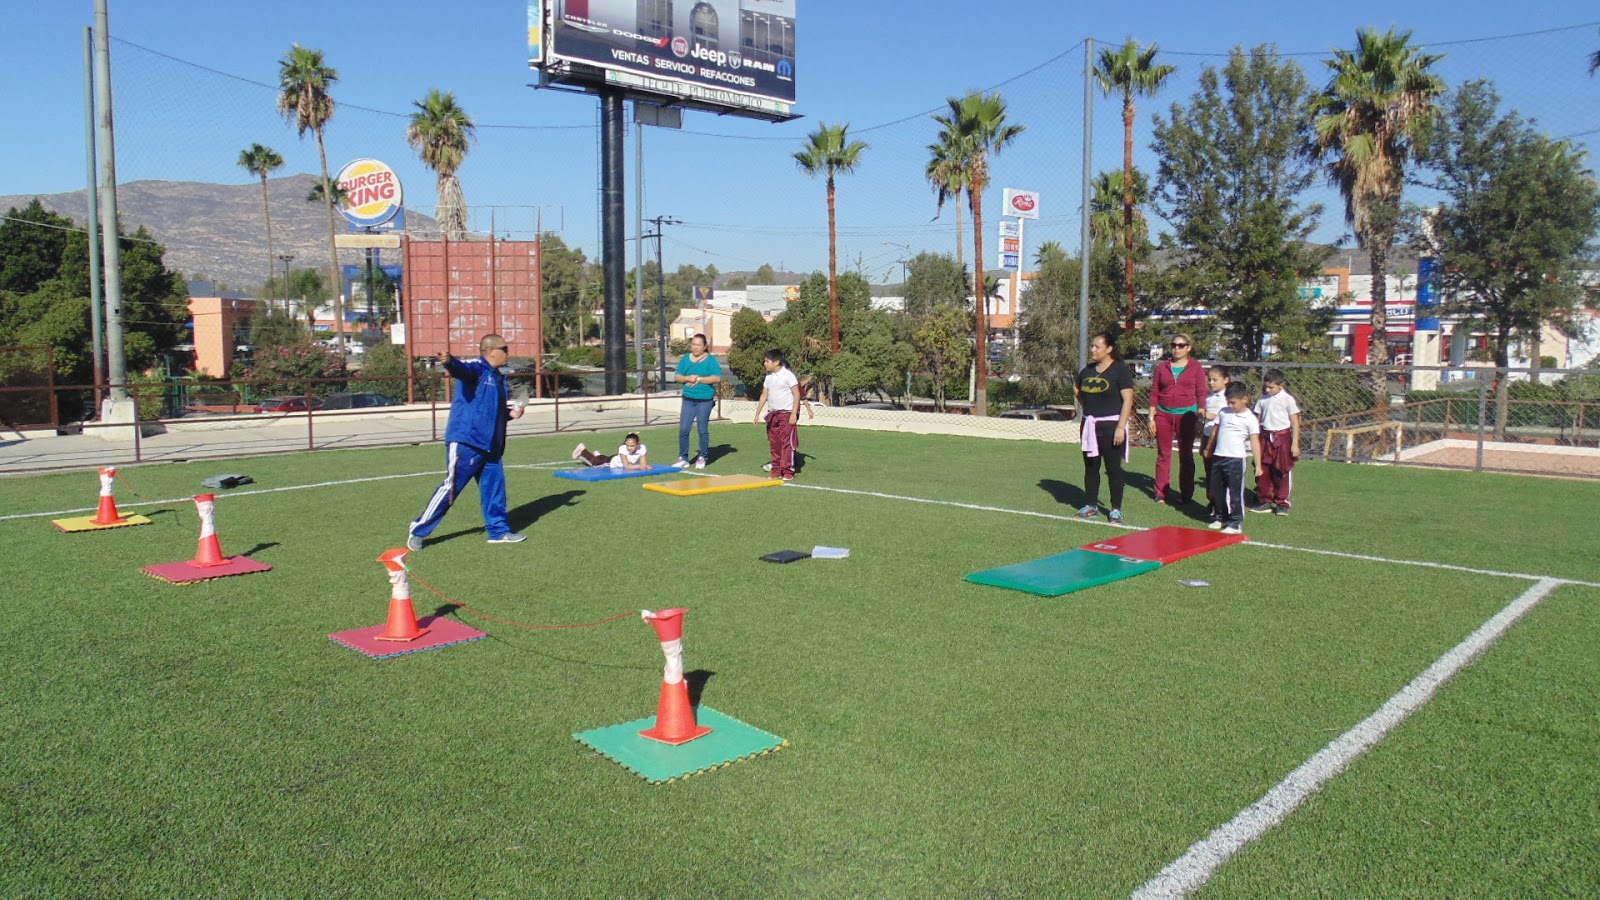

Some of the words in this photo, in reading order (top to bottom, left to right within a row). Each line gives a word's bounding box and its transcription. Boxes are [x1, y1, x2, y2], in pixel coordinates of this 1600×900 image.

[565, 14, 608, 27] CHRYSLER
[612, 29, 660, 44] DODGE
[690, 43, 726, 66] Jeep
[611, 48, 650, 65] VENTAS
[654, 58, 696, 75] SERVICIO
[700, 67, 755, 87] REFACCIONES
[742, 59, 775, 72] RAM
[340, 171, 392, 192] BURGER
[343, 182, 395, 211] KING
